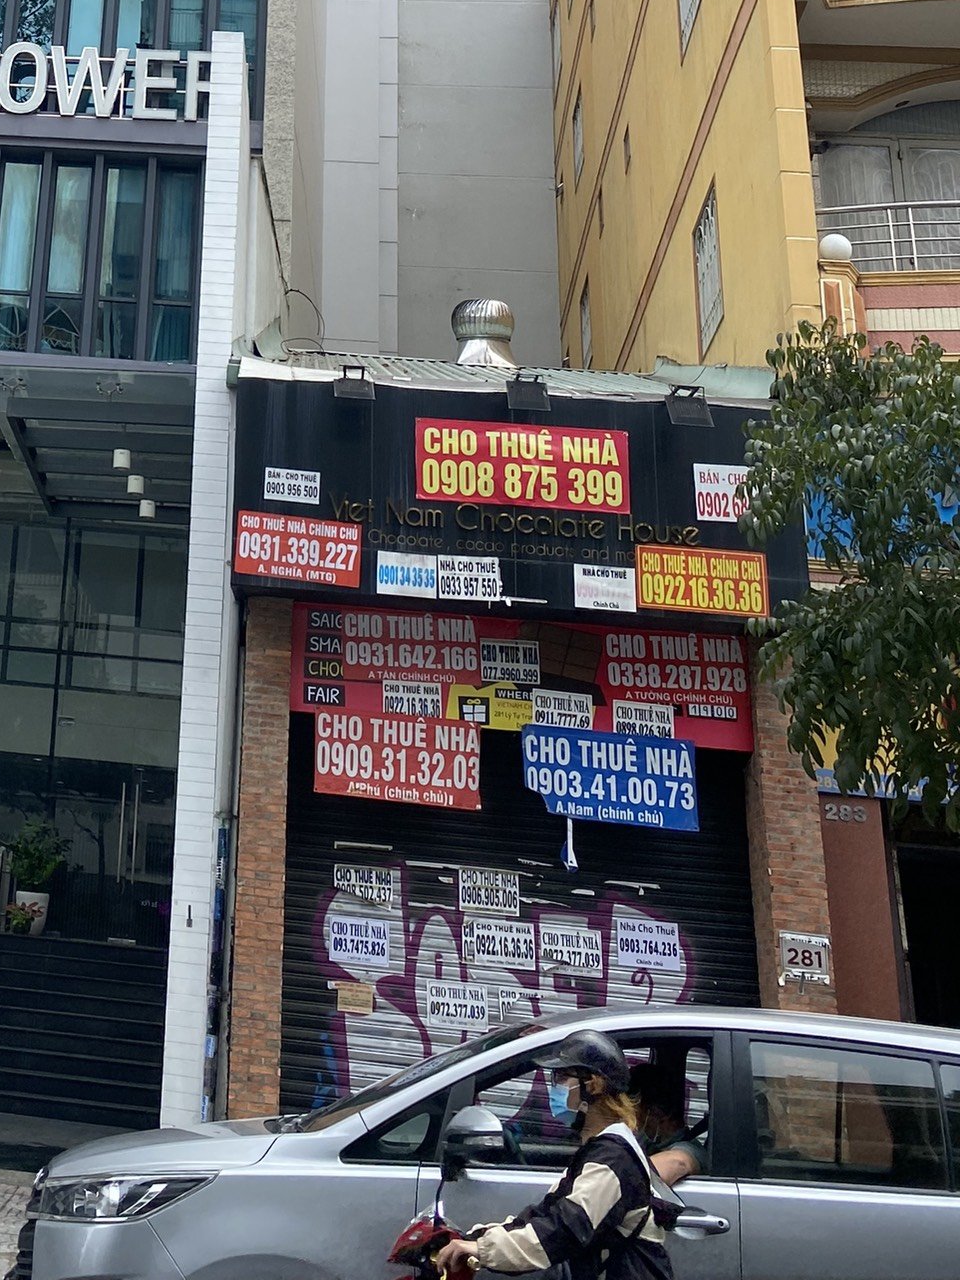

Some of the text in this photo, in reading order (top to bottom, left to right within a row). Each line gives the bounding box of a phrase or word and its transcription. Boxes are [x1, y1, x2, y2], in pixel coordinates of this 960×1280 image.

[423, 427, 620, 466] CHO THUÊ NHÀ
[286, 473, 299, 482] CHO
[300, 473, 317, 483] THUÊ
[422, 458, 623, 507] 0908 875 399
[699, 469, 720, 485] BÁN
[266, 481, 318, 499] 0903 956 500
[697, 491, 730, 518] 0902
[241, 515, 358, 540] CHO THUÊ NHÀ CHÍNH CHỦ
[329, 491, 701, 546] Viet Nam Chocolate House
[239, 531, 358, 571] 0931.339.227
[456, 537, 609, 561] cacao products and
[258, 564, 268, 573] A.
[306, 569, 336, 583] (MTG)
[440, 559, 496, 573] NHÀ CHO THUÊ
[596, 568, 610, 578] CHO
[610, 569, 627, 579] THUÊ
[642, 551, 761, 582] CHO THUÊ NHÀ CHÍNH CHỦ
[440, 576, 497, 597] 0933 957 550
[642, 574, 763, 612] 0922.16.36.36
[344, 613, 477, 643] CHO THUÊ NHÀ
[345, 641, 478, 670] 0931.642.166
[481, 643, 497, 663] CHO
[499, 641, 520, 664] THUÊ
[605, 633, 744, 664] CHO THUÊ NHÀ
[483, 666, 539, 683] 077.9960.999
[607, 661, 747, 693] 0338.287.928
[307, 686, 339, 703] FAIR
[384, 684, 440, 696] CHO THUÊ NHÀ
[384, 695, 440, 718] 0922.16.36.36
[535, 694, 590, 714] CHO THUÊ NHÀ
[535, 709, 590, 729] 0911.7777.69
[616, 706, 671, 725] CHO THUÊ NHÀ
[317, 712, 480, 753] CHO THUÊ NHÀ
[316, 740, 480, 791] 0909.31.32.03
[525, 734, 694, 779] CHO THUÊ NHÀ
[384, 785, 419, 800] (chính
[525, 766, 695, 811] 0903.41.00.73
[555, 800, 664, 827] A.Nam (chính chủ)
[825, 803, 867, 822] 283
[335, 868, 352, 882] CHO
[461, 870, 477, 884] CHO
[461, 886, 518, 909] 0906.905.006
[332, 921, 387, 940] CHO THUÊ NHÀ
[476, 923, 531, 935] CHO THUÊ NHÀ
[620, 922, 675, 936] Nhà Cho Thuê
[333, 937, 386, 956] 093.7475.826
[475, 934, 534, 960] 0922.16.36.36
[542, 931, 600, 950] CHO THUÊ NHÀ
[619, 937, 677, 957] 0903.764.236
[543, 948, 600, 968] 0972377.039
[787, 947, 822, 968] 281
[430, 986, 484, 1002] CHO THUÊ NHÀ
[500, 990, 517, 998] CHO
[430, 1001, 485, 1020] 0972.377.039
